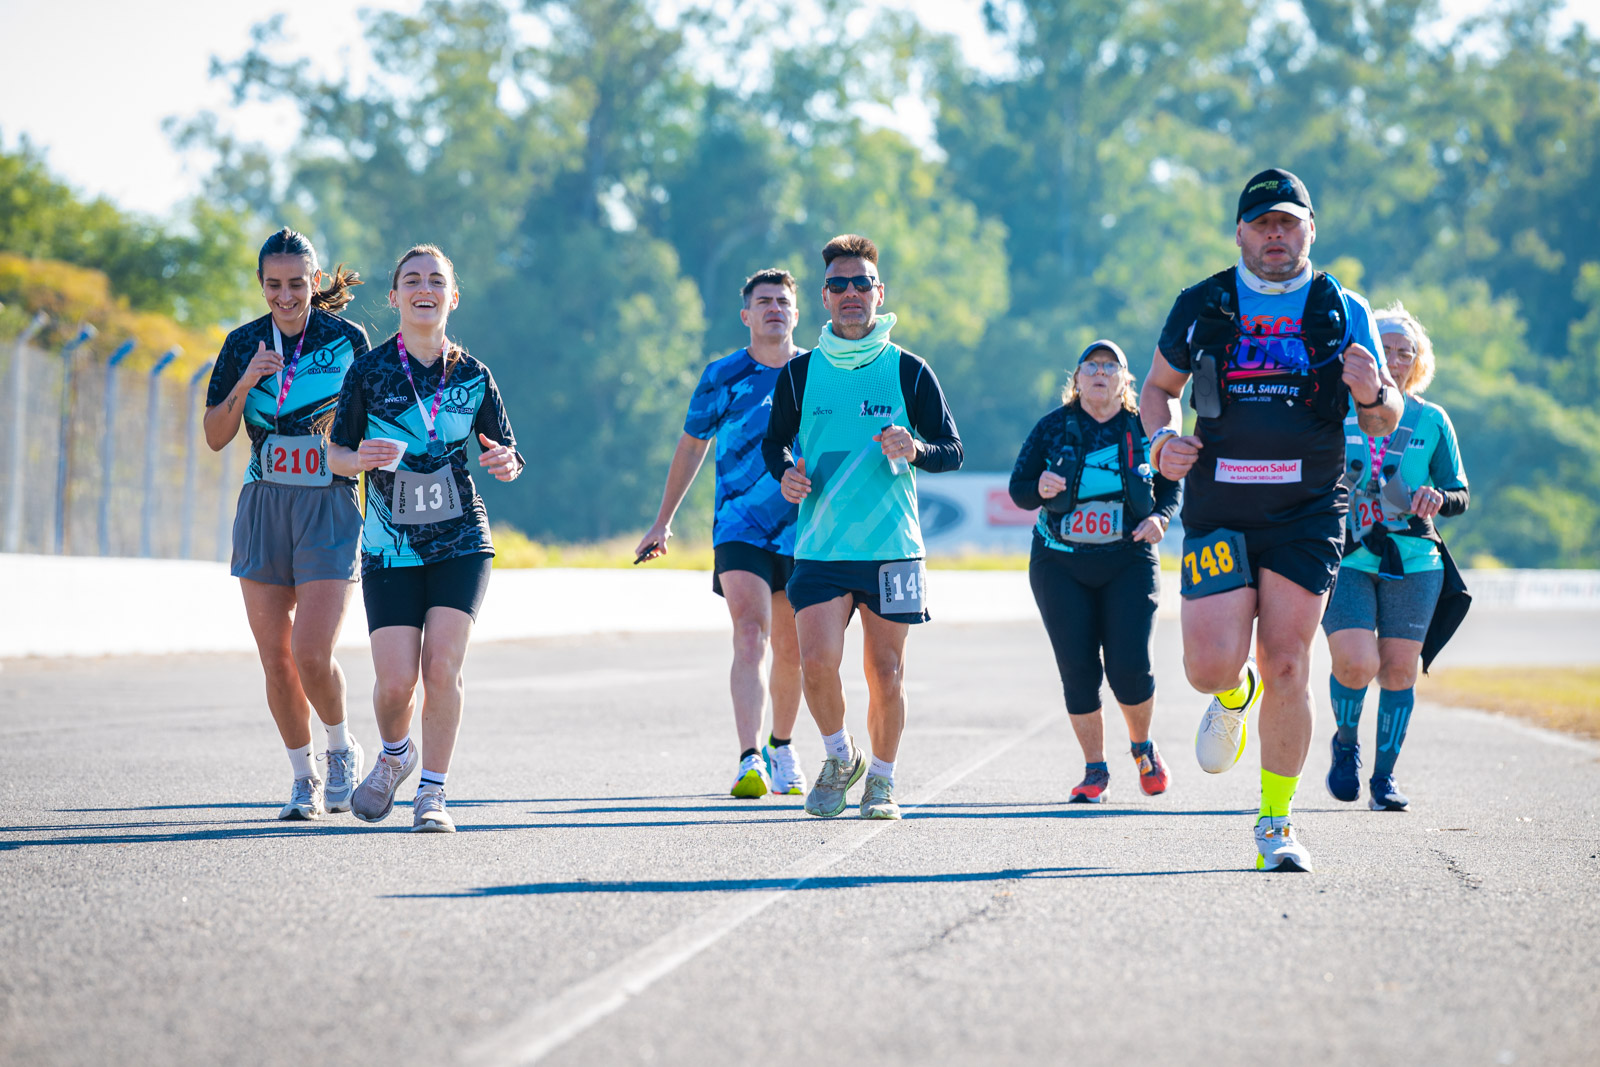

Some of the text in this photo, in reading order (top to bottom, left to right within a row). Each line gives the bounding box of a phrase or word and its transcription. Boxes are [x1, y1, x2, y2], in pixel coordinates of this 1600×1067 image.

[385, 395, 408, 404] INVICTO
[1258, 384, 1288, 395] SANTA
[1289, 386, 1300, 397] FE
[273, 446, 320, 475] 210
[1270, 462, 1297, 473] Salud
[414, 482, 443, 512] 13
[1071, 510, 1112, 535] 266
[1358, 500, 1395, 528] 26
[1183, 540, 1234, 586] 748
